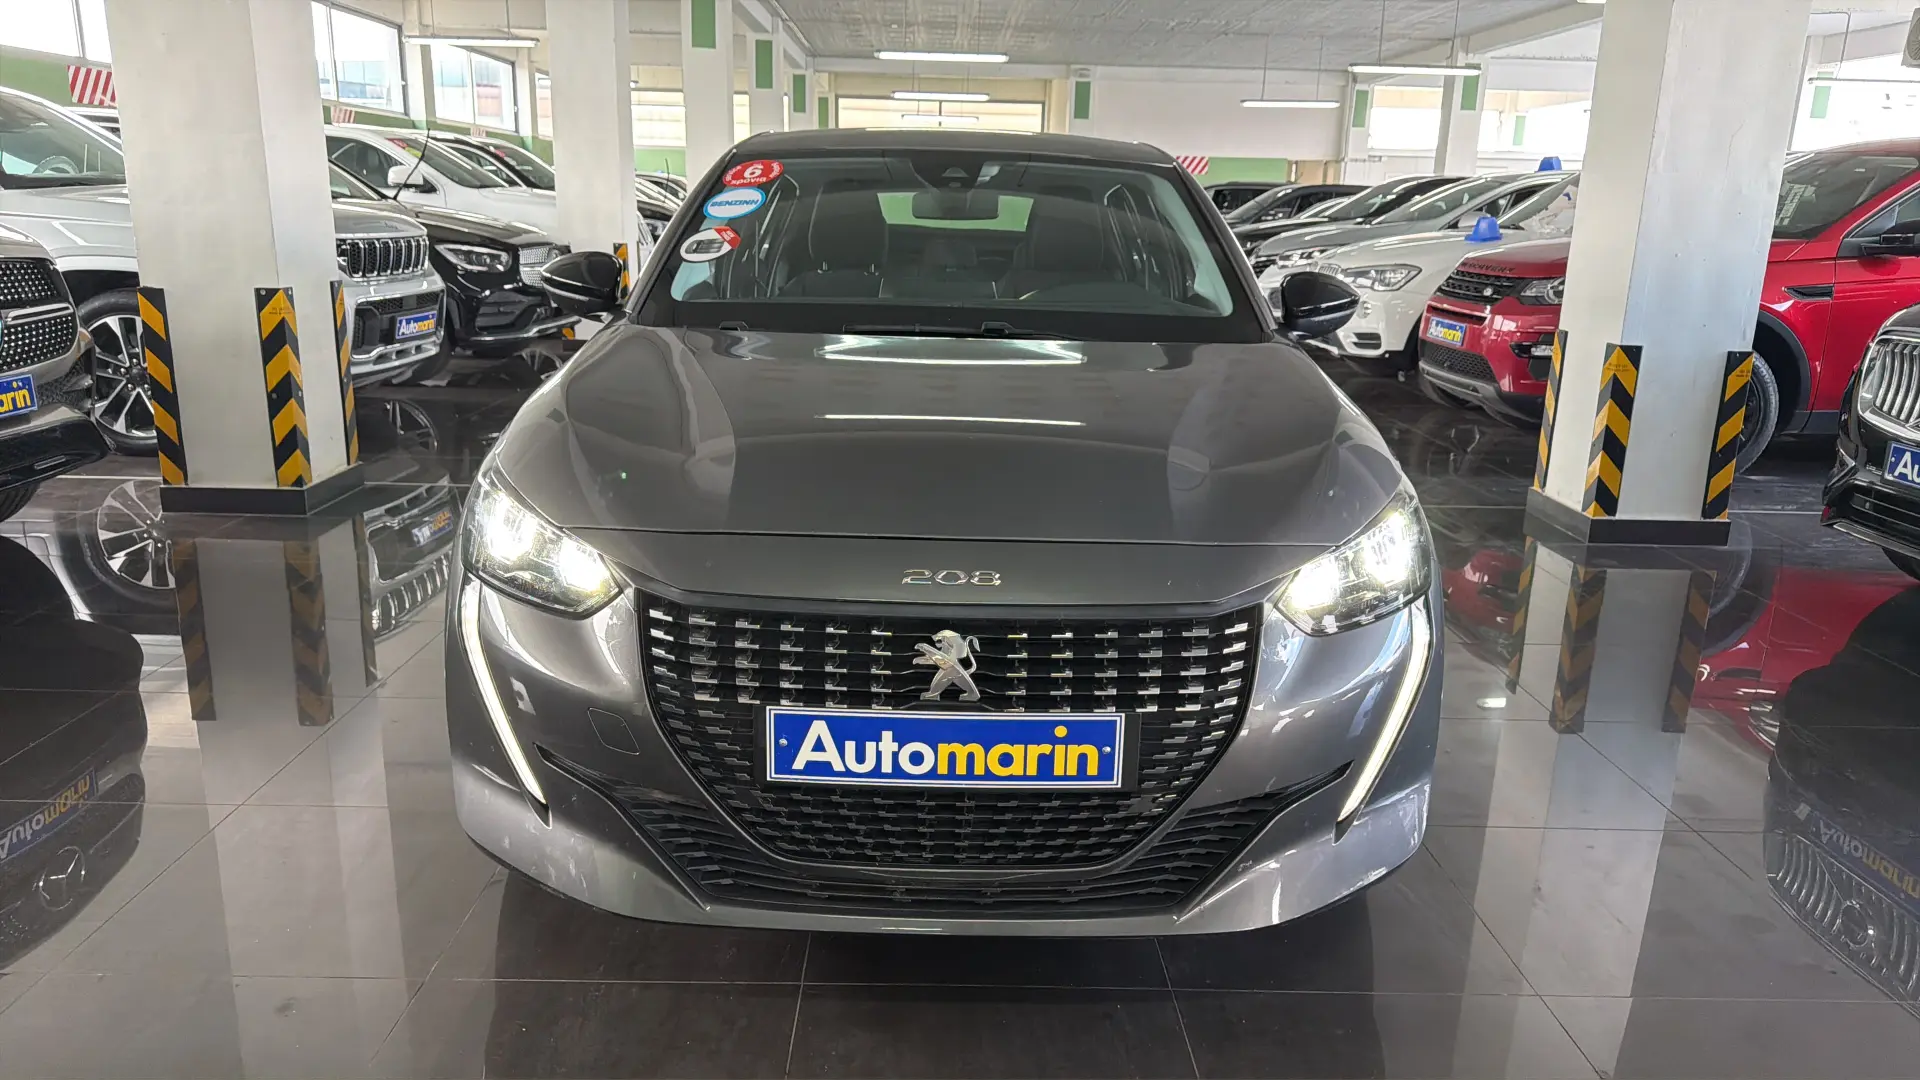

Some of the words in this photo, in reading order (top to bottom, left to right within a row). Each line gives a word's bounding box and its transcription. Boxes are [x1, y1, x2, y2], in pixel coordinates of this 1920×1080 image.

[743, 163, 764, 178] 6
[902, 569, 1001, 586] 208
[792, 720, 1098, 776] Automarin
